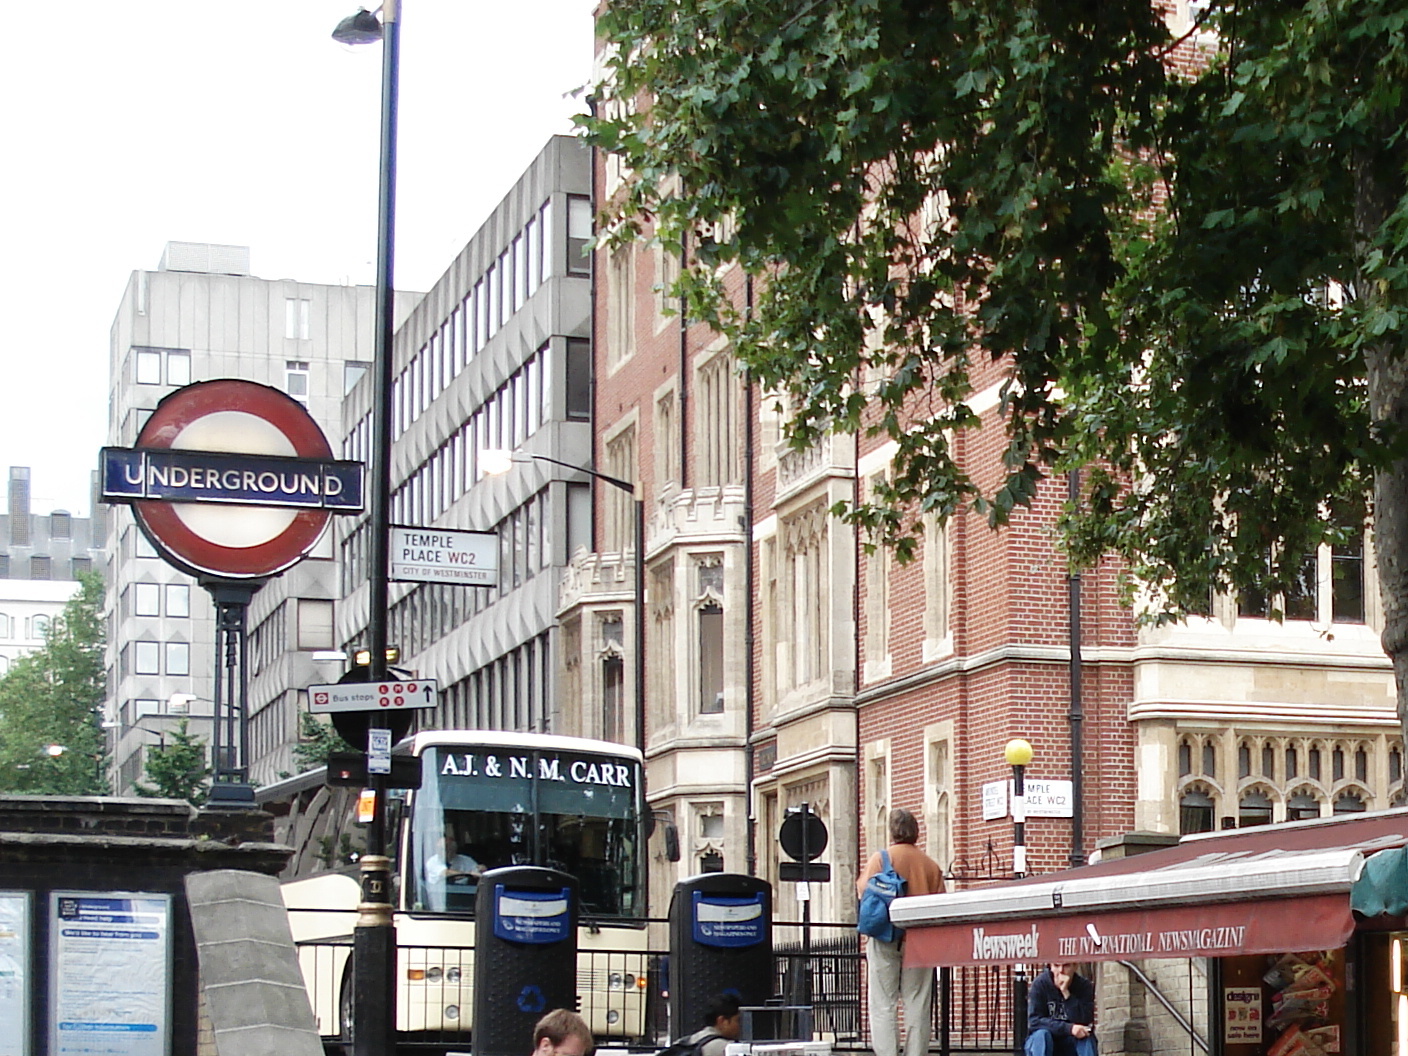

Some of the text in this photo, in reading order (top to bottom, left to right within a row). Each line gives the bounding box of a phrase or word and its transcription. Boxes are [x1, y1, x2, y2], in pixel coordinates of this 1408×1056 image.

[125, 464, 343, 496] UNDERGROUND
[404, 534, 453, 548] TEMPLE
[403, 549, 475, 565] PLACE WC2
[403, 567, 419, 575] CITY
[434, 569, 487, 579] WESTMINSTER
[351, 693, 375, 702] stops
[485, 755, 502, 777] &
[570, 761, 631, 787] CARR
[973, 924, 1039, 960] Newsweek
[1058, 937, 1078, 956] THE
